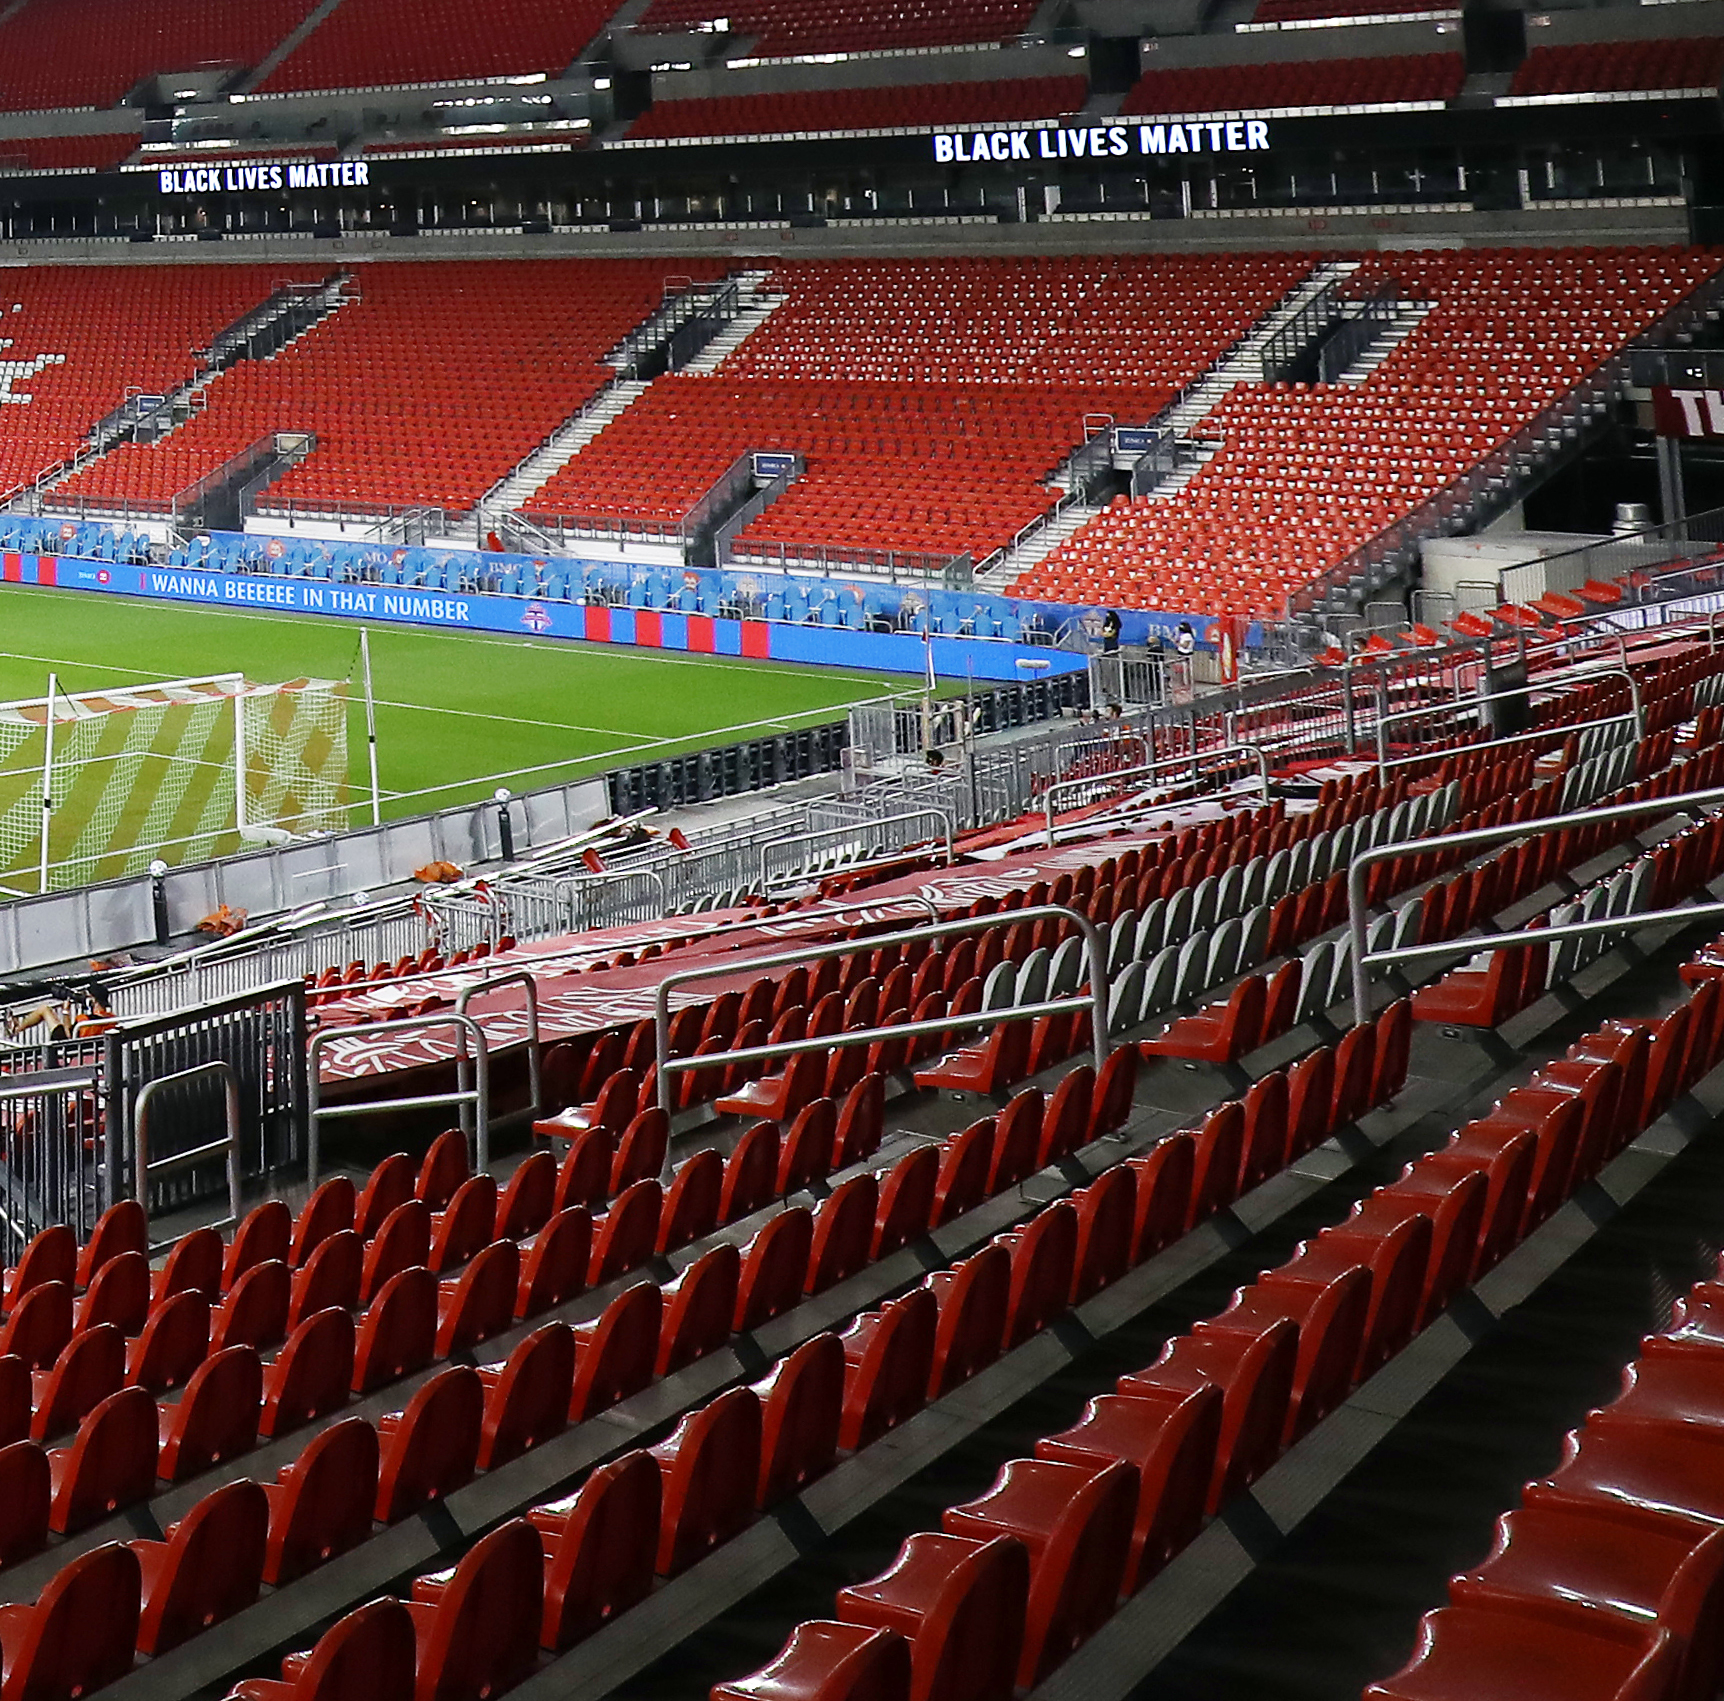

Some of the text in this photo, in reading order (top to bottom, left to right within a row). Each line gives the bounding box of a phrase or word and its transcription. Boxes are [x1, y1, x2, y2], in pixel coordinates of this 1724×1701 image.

[933, 120, 1270, 163] BLACK LIVES MATTER
[160, 161, 370, 194] BLACK LIVES MATTER
[152, 574, 470, 622] WANNA BEEEEEE IN THAT NUMBER
